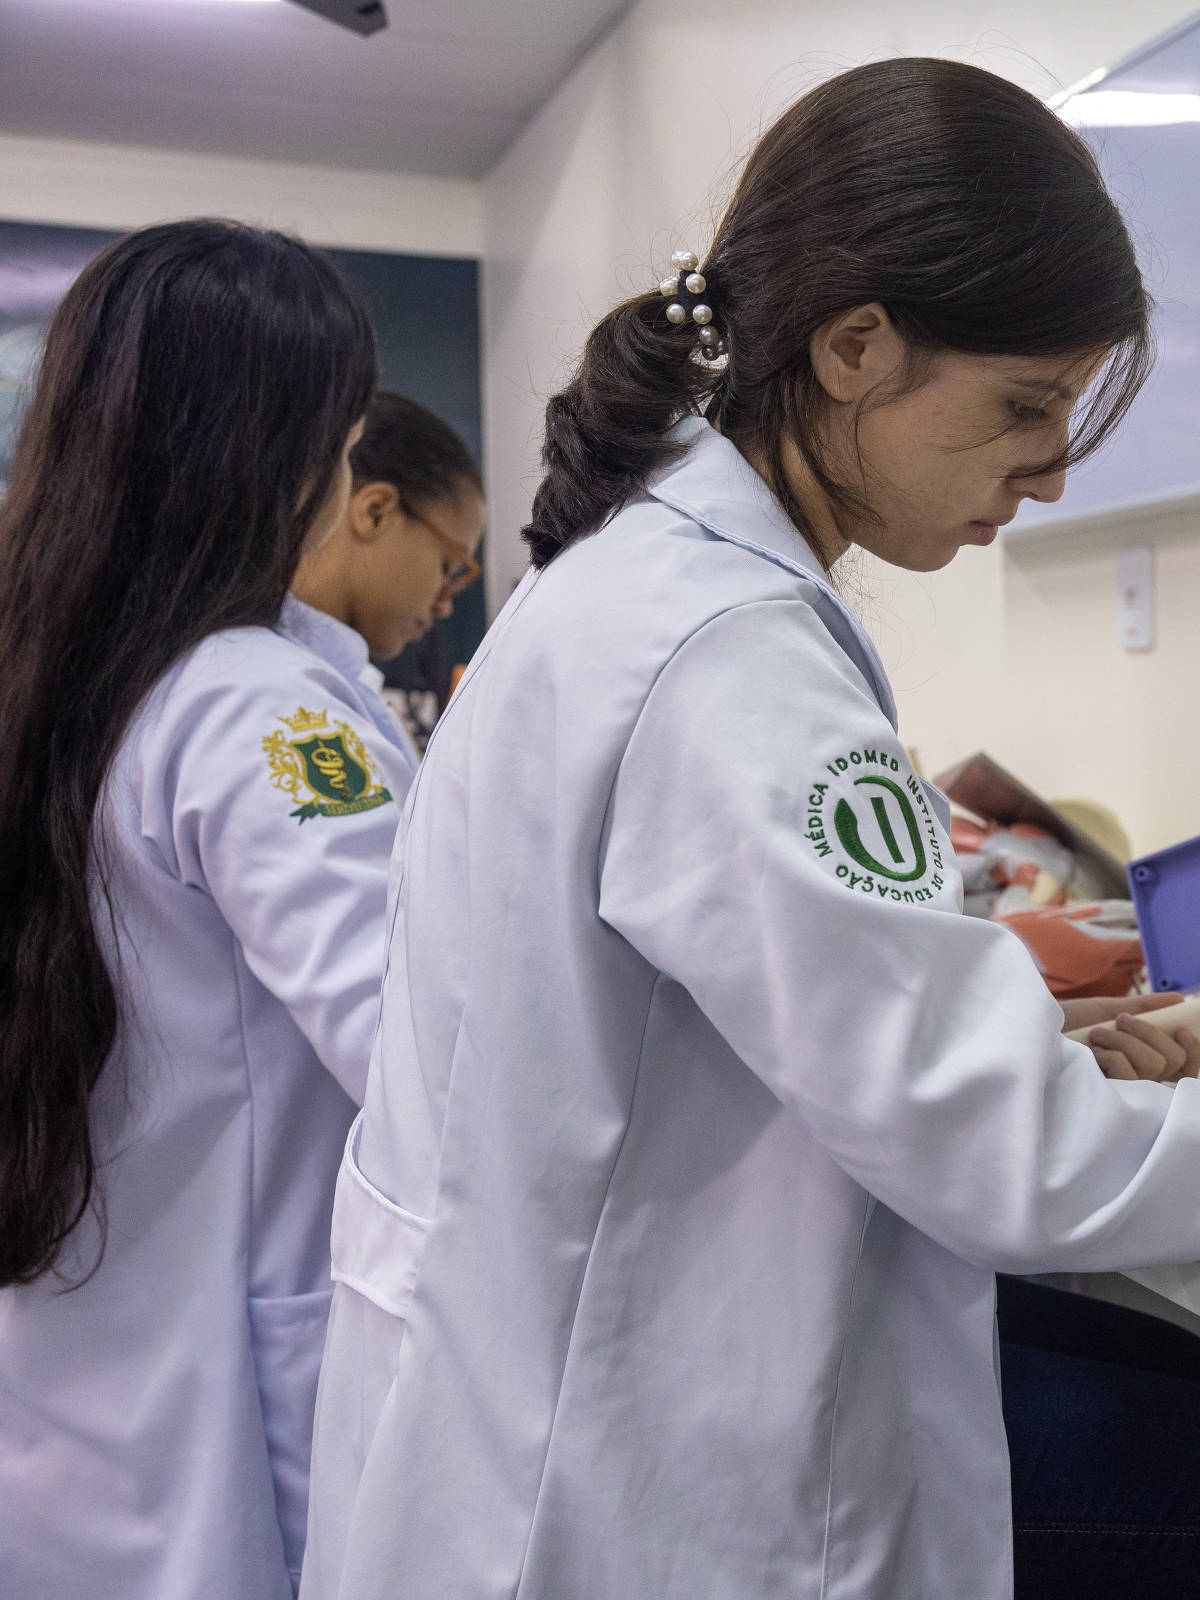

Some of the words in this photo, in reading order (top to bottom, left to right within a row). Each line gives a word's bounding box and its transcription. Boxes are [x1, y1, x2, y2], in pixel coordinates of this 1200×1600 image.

[827, 750, 899, 776] IDOMED
[804, 783, 834, 857] MÉDICA
[907, 775, 944, 870] INSTITUTO
[835, 864, 934, 903] EDUCAÇÃO
[931, 872, 944, 891] DE
